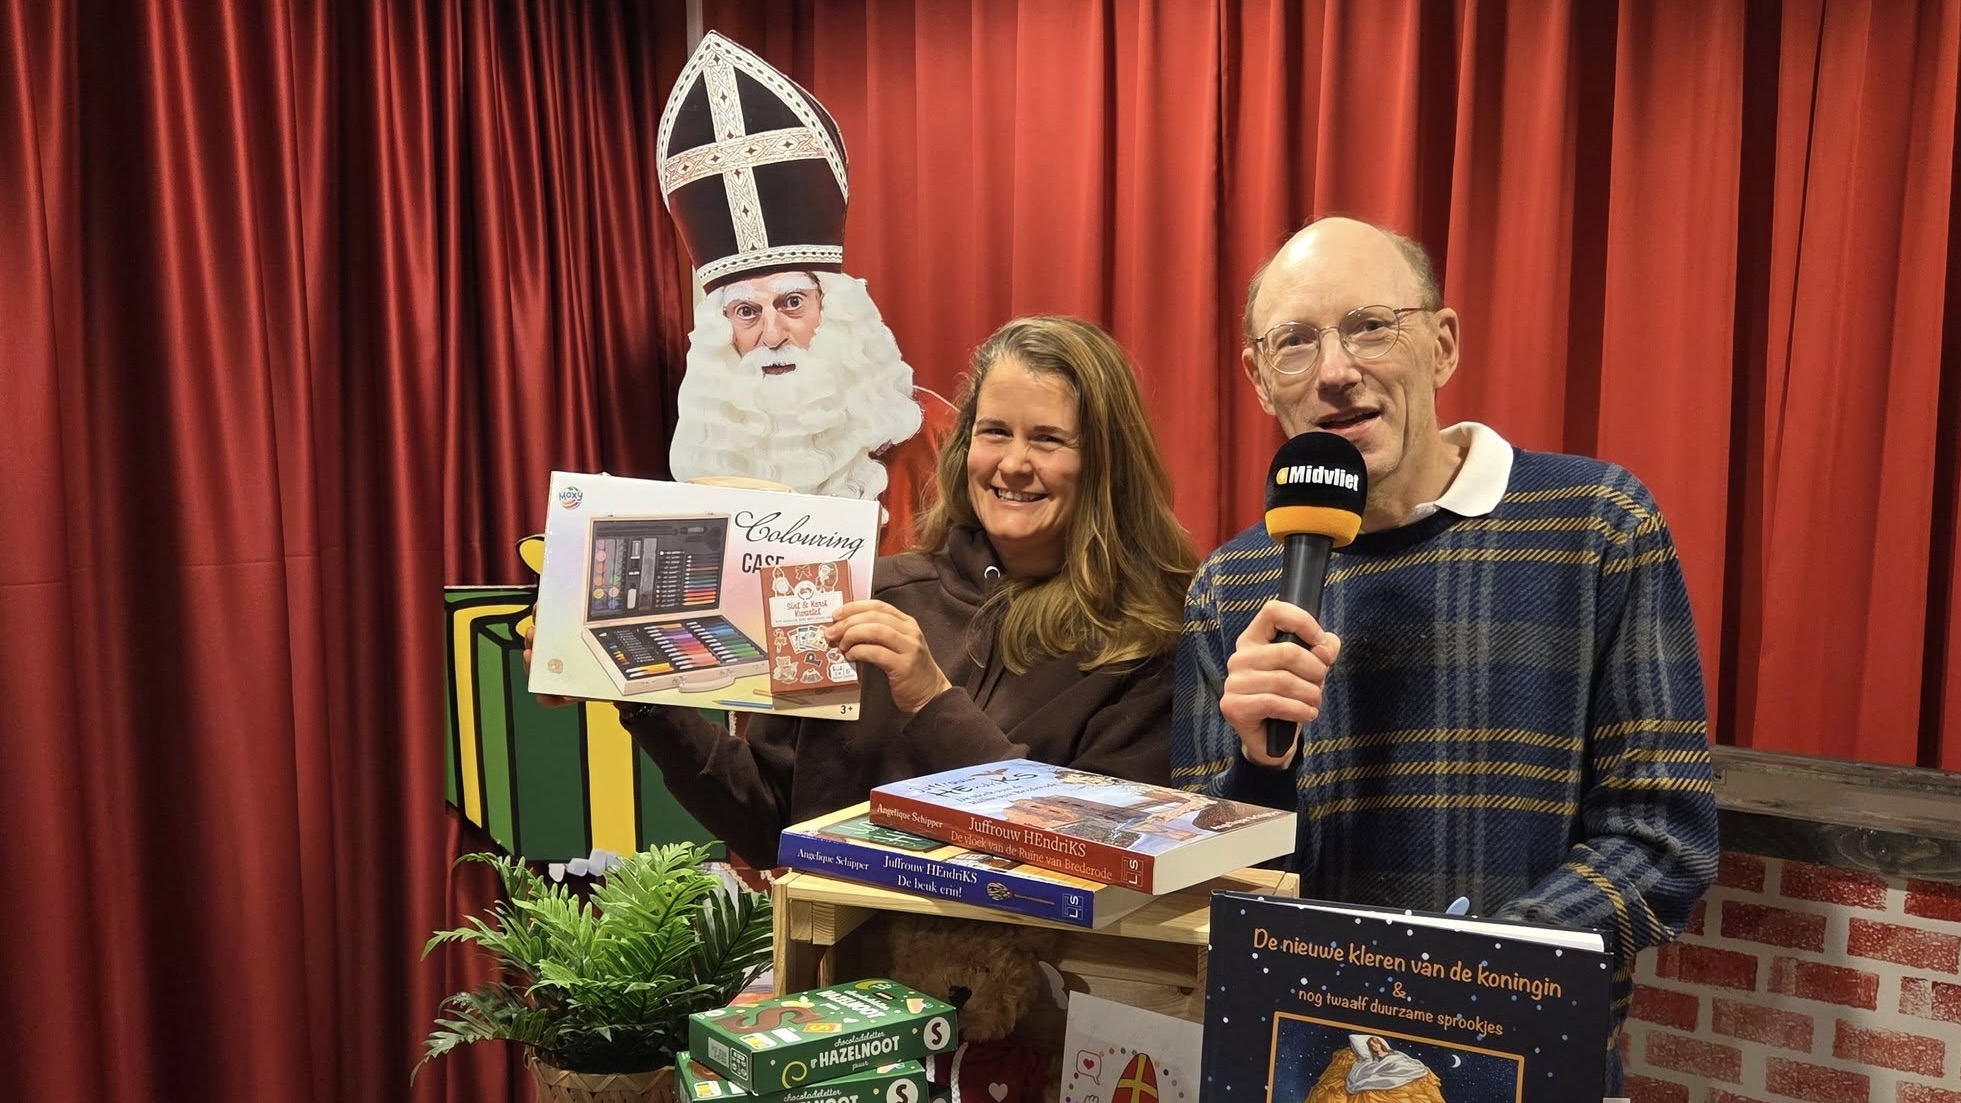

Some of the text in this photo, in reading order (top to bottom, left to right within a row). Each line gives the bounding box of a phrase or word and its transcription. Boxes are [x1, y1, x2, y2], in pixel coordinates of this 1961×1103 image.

[1289, 465, 1359, 491] Midvliet
[735, 511, 864, 559] Colouring
[877, 804, 943, 828] Angelique Schipper
[969, 817, 1086, 857] Juffrouw HEndriKS
[797, 848, 869, 871] Angelique Schipper
[951, 830, 963, 842] De
[964, 833, 987, 847] vloek
[988, 841, 1004, 851] van
[1005, 844, 1017, 855] de
[1045, 856, 1062, 868] van
[1064, 859, 1113, 881] Brederode
[883, 855, 978, 883] Juffrouw HEndriKS
[897, 875, 962, 898] De beuk erin!
[1253, 928, 1562, 1001] De nieuwe kleren van de koningin
[1392, 981, 1407, 999] &
[1298, 989, 1504, 1037] nog twaalf duurzame sprookjes
[834, 1031, 885, 1048] chocoladeletter
[931, 1022, 942, 1046] S
[819, 1036, 900, 1068] HAZELNOOT
[783, 1088, 842, 1102] chocoladeletter
